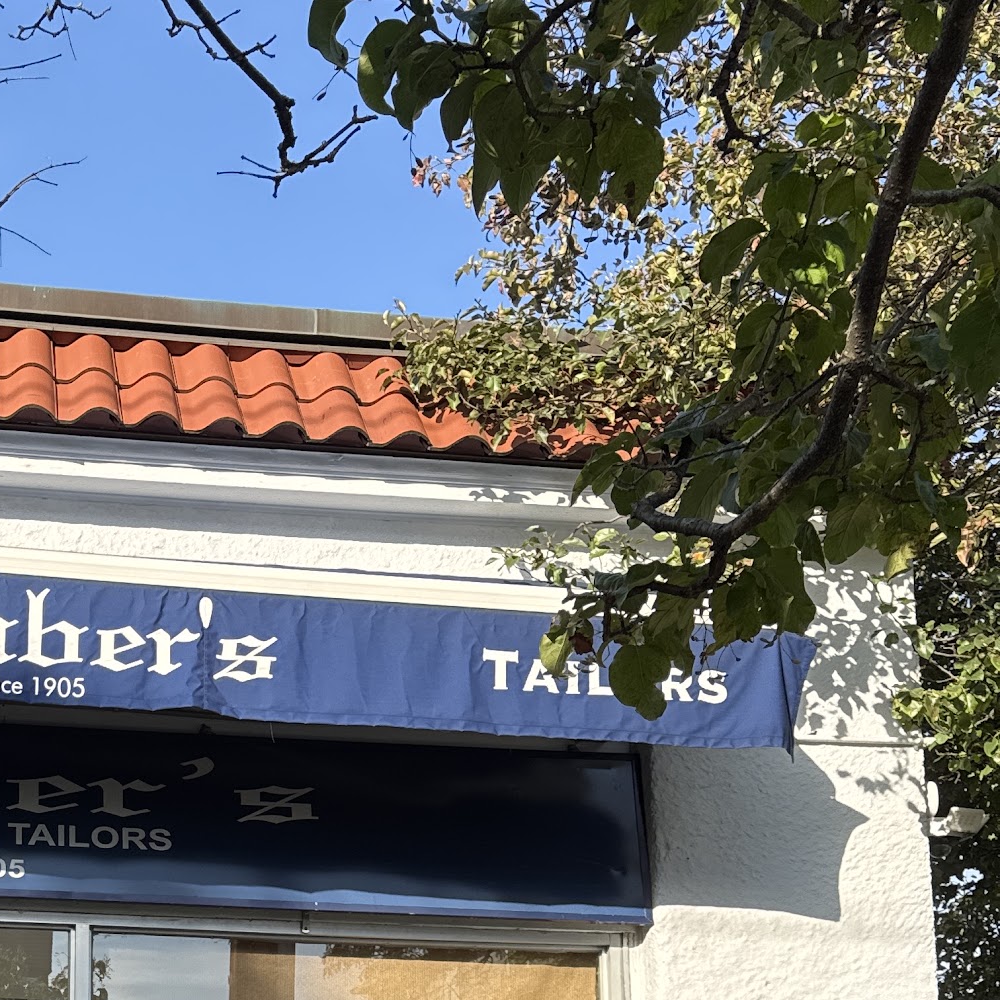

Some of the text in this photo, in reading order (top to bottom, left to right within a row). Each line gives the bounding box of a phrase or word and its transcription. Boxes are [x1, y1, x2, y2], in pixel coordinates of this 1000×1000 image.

[32, 676, 86, 698] 1905
[482, 647, 729, 705] TAILRS
[7, 822, 172, 852] TAILORS
